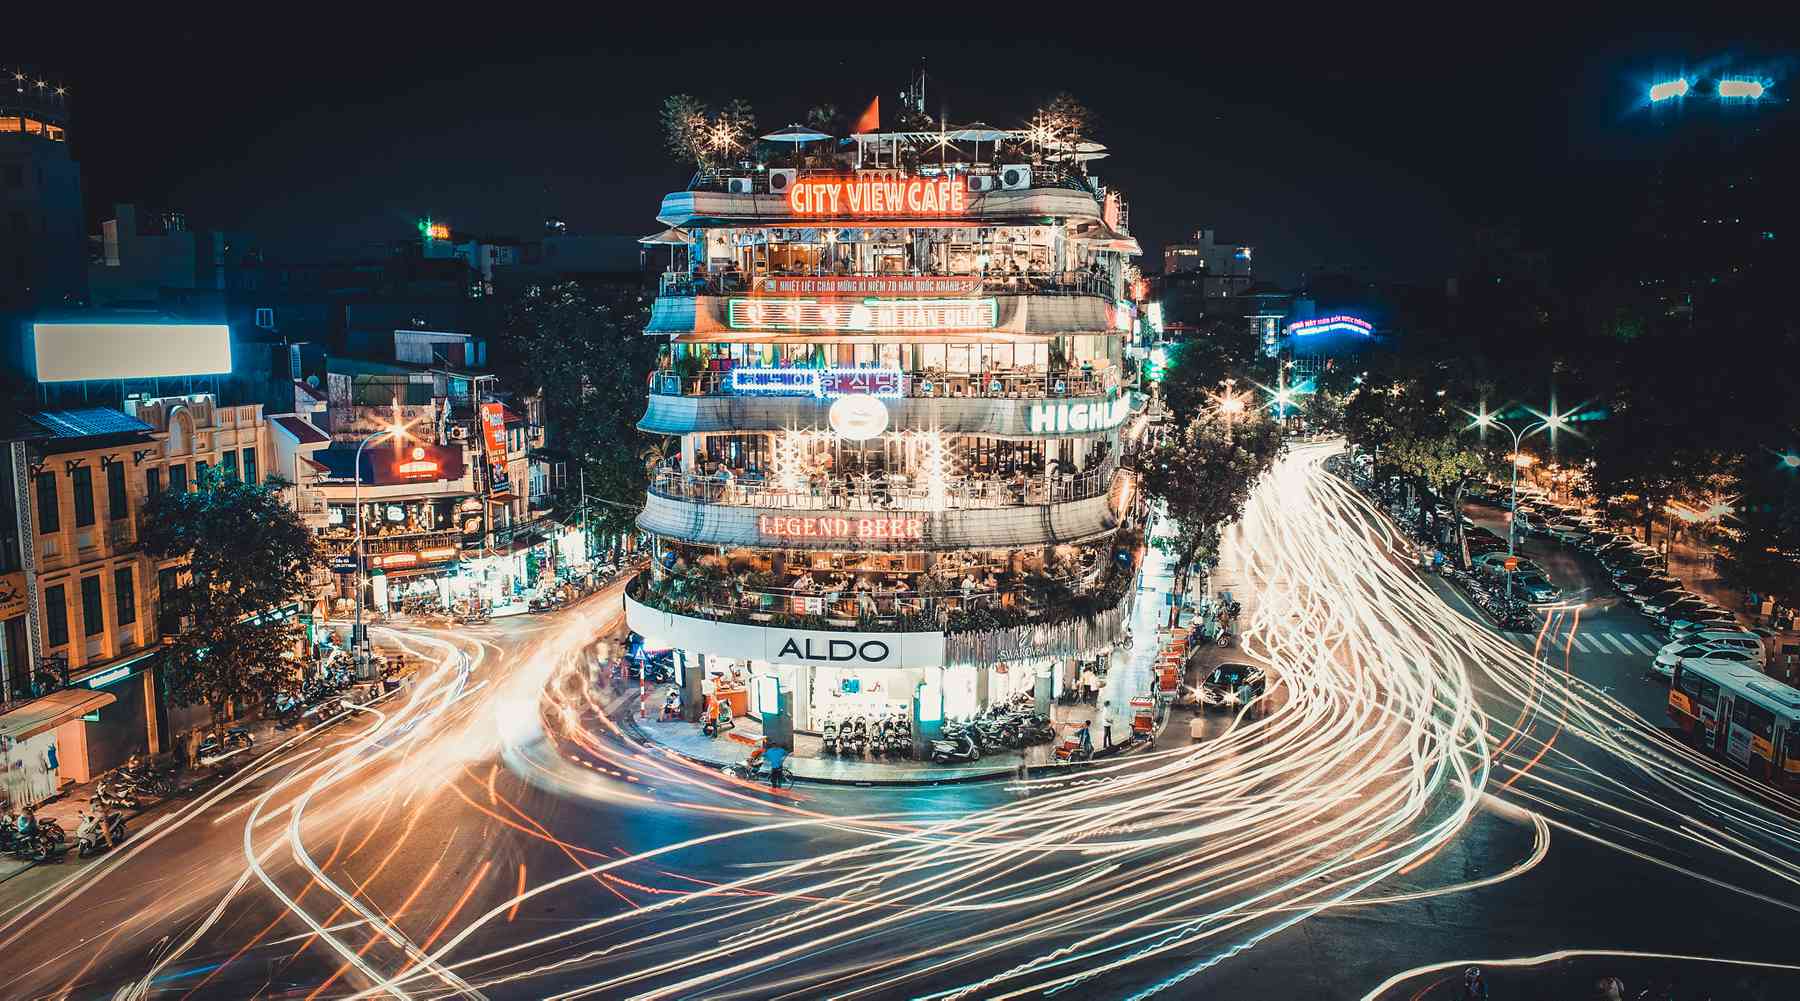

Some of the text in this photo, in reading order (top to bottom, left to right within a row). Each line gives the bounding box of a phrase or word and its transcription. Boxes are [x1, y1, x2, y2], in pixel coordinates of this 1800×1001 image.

[790, 181, 964, 213] CITY VIEW CAFE
[760, 513, 922, 538] LEGEND BEER
[778, 637, 889, 662] ALDO
